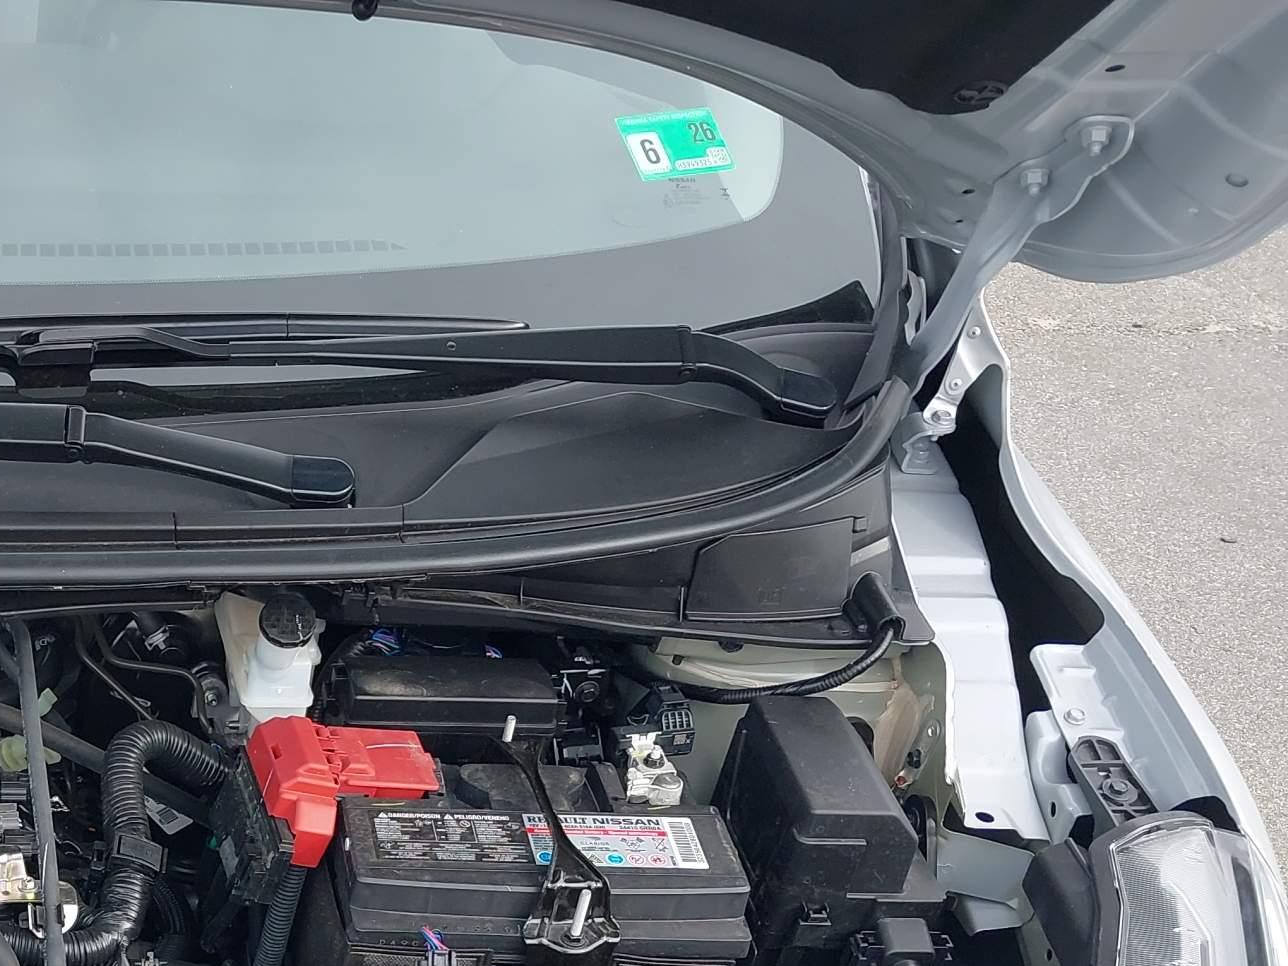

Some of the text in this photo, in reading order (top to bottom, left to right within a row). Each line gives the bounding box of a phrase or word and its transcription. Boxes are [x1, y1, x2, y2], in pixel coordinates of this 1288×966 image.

[688, 121, 716, 143] 26
[639, 139, 661, 165] 6
[593, 818, 661, 826] NISSAN
